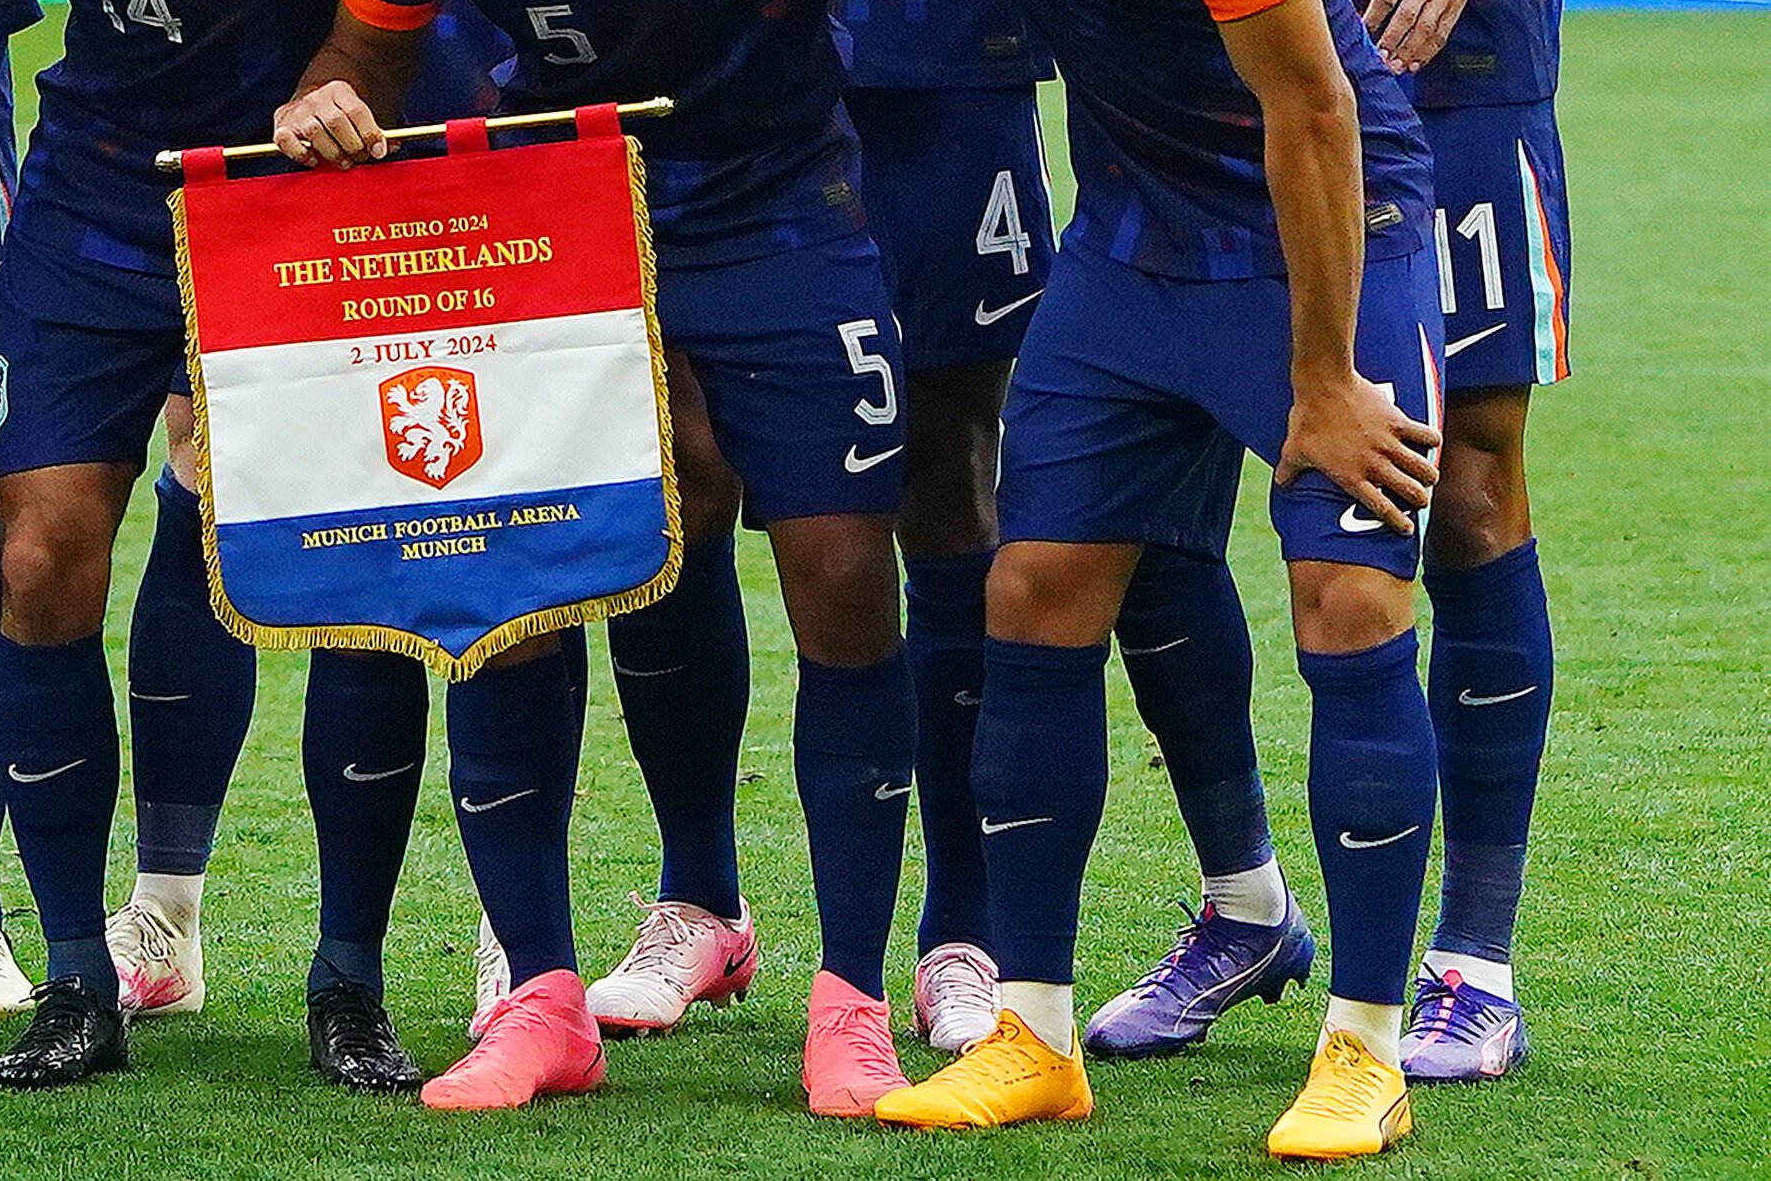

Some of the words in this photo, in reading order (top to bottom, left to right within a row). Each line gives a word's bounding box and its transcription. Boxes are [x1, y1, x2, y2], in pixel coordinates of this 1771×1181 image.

[525, 4, 598, 66] 5
[331, 225, 387, 244] UEFA
[388, 221, 444, 240] EURO
[448, 214, 489, 234] 2024
[975, 170, 1031, 276] 4
[273, 258, 334, 288] THE
[338, 235, 553, 282] NETHERLANDS
[1434, 202, 1506, 315] 11
[341, 294, 431, 321] ROUND
[436, 290, 469, 312] OF
[473, 287, 495, 309] 16
[350, 346, 364, 365] 2
[374, 339, 435, 363] JULY
[447, 333, 498, 356] 2024
[837, 318, 898, 426] 5
[302, 524, 389, 549] MUNICH
[394, 512, 503, 539] FOOTBALL
[508, 503, 581, 526] ARENA
[401, 535, 488, 561] MUNICH
